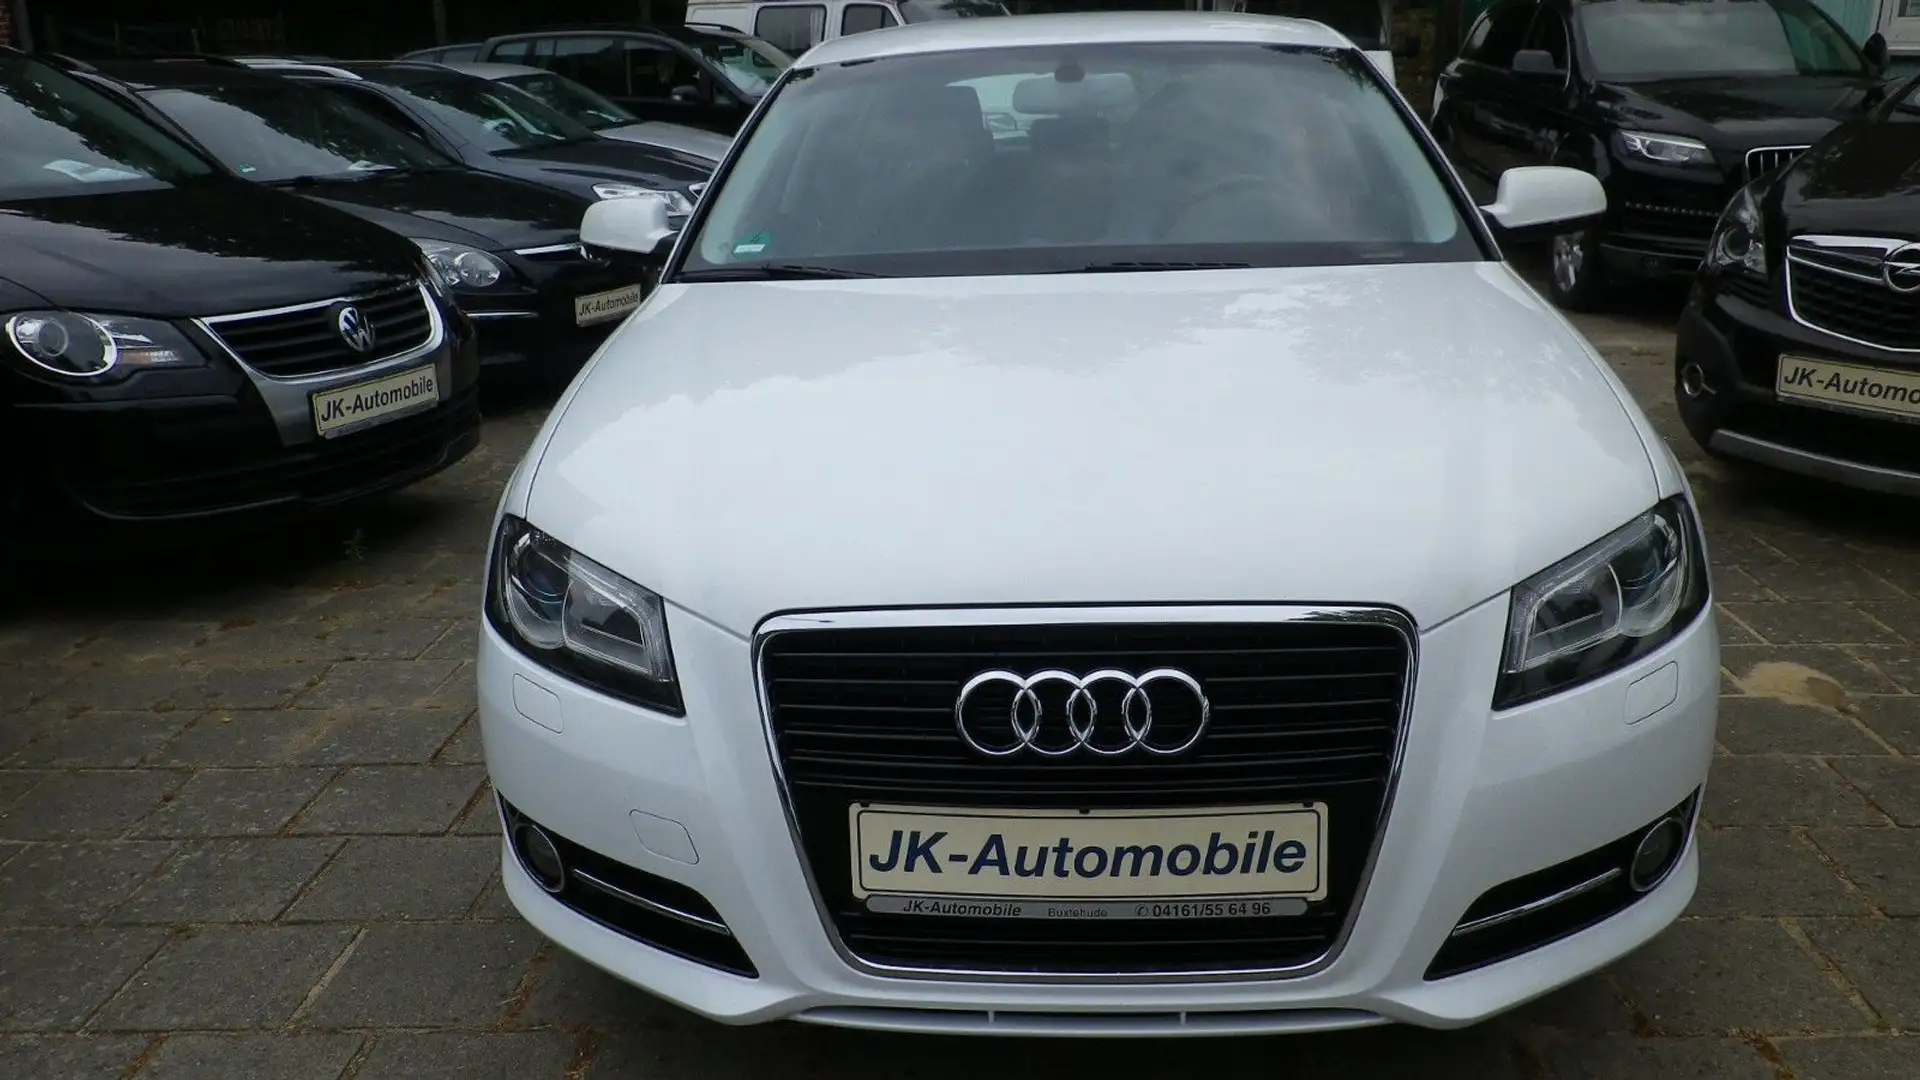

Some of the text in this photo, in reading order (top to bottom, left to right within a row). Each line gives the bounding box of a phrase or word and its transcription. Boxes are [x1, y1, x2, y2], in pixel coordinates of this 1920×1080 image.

[321, 376, 434, 422] JK-Automobile
[869, 830, 1307, 878] JK-Automobile
[903, 900, 1271, 918] JK-Automobile Buxtehude 04161/55 64 96
